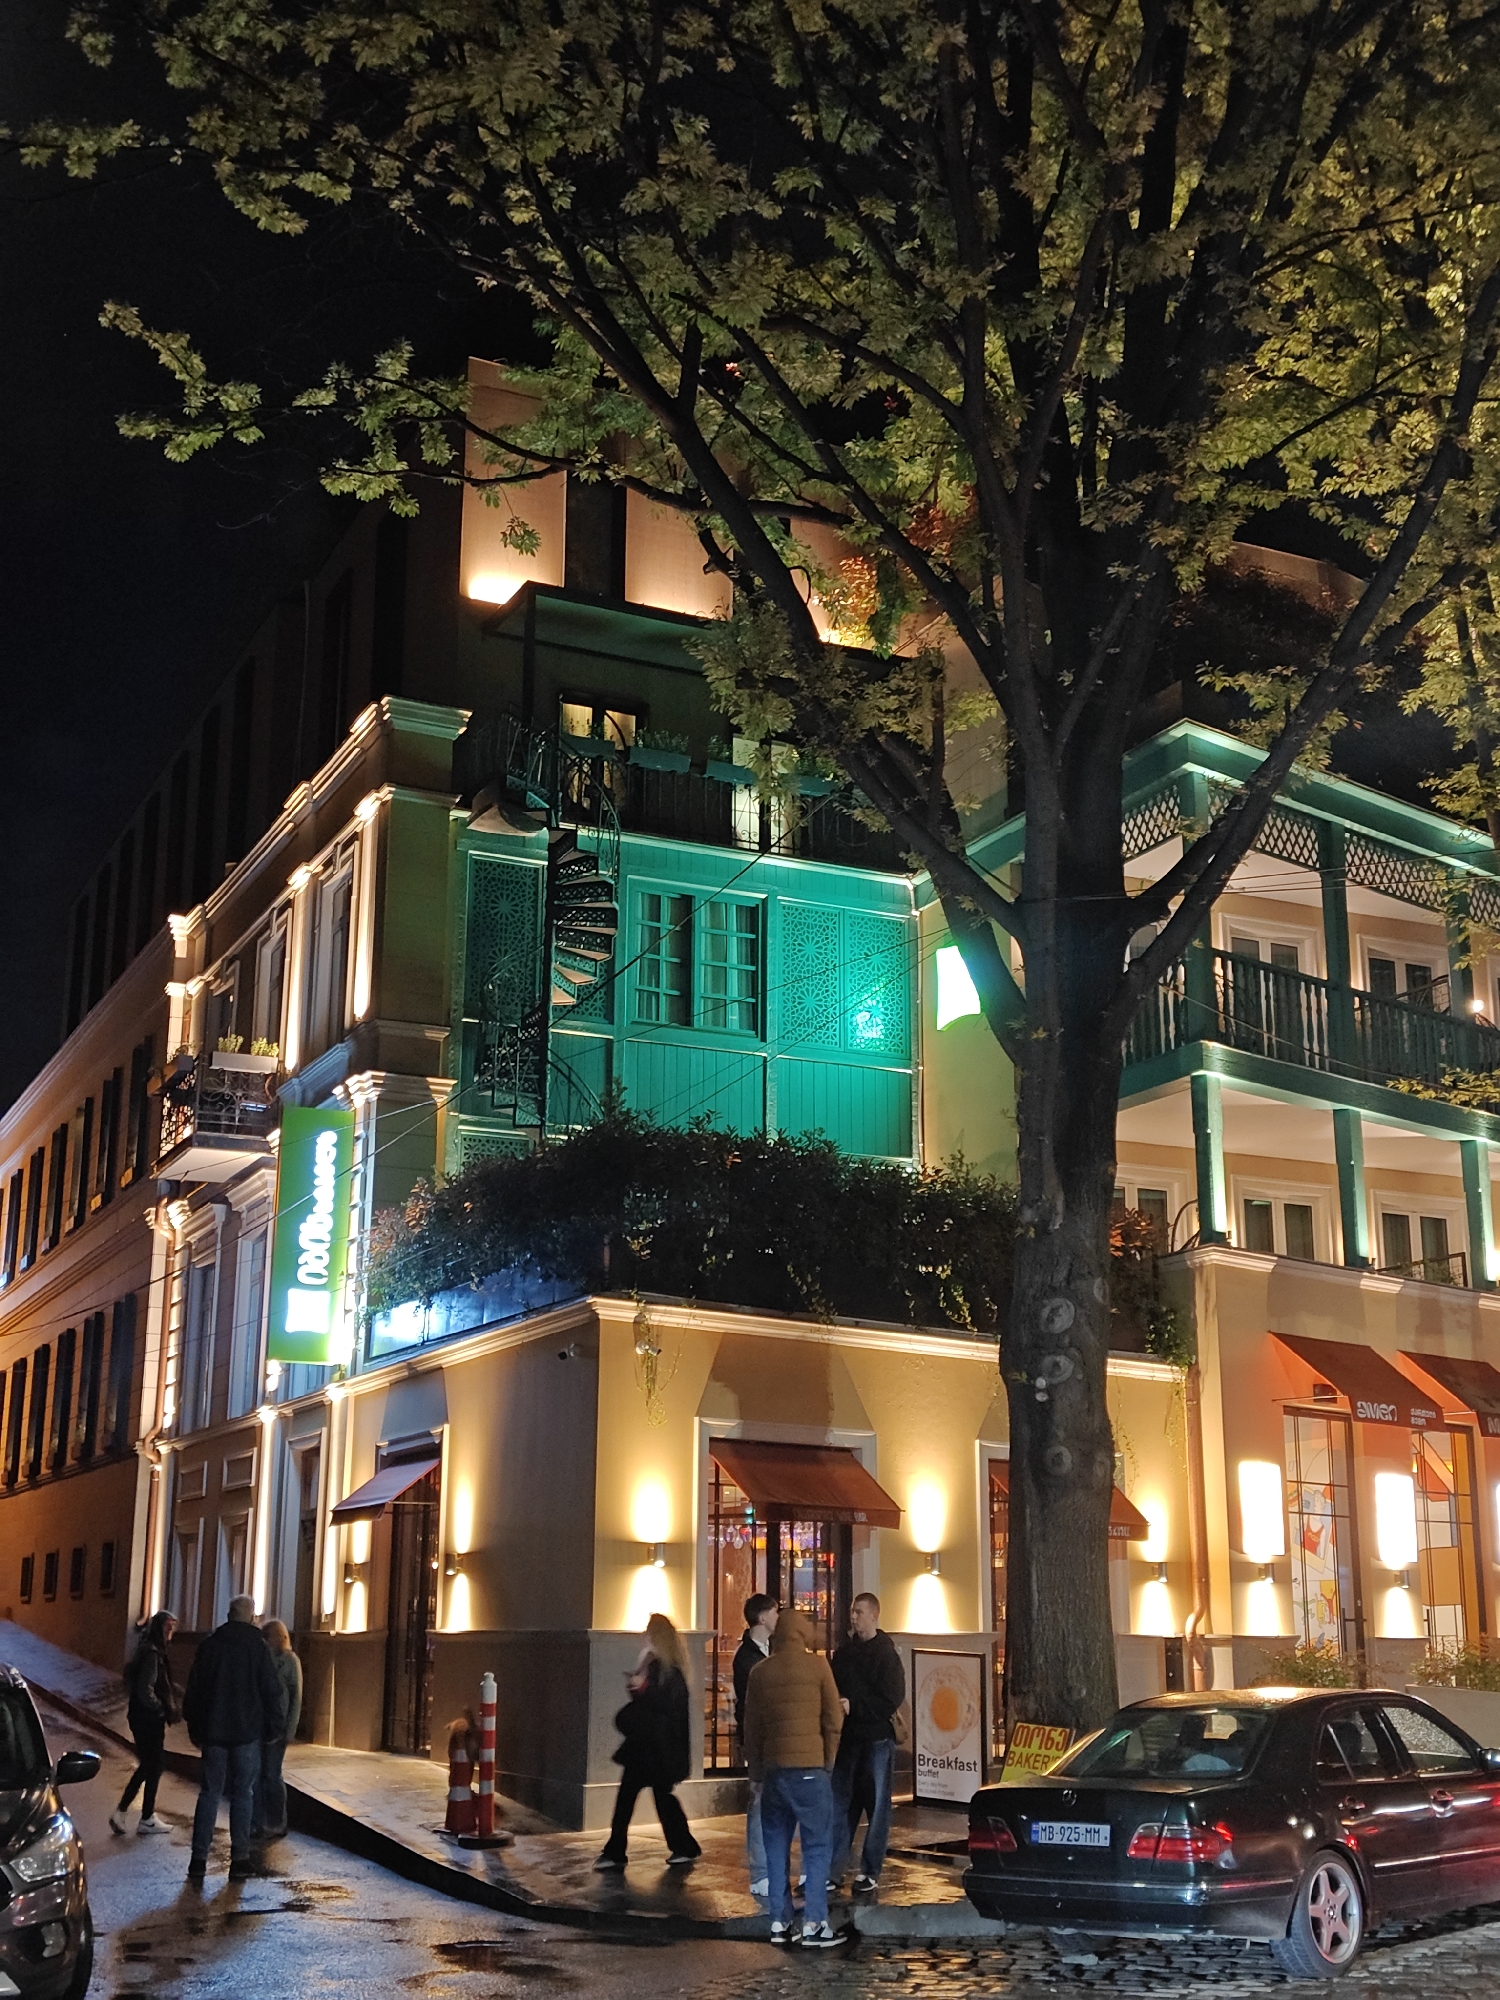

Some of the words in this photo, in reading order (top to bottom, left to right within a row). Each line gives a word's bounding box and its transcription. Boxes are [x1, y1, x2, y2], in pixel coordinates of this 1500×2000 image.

[918, 1753, 977, 1772] Breakfast
[917, 1768, 940, 1779] buffet
[1040, 1824, 1101, 1844] MB-925-MM
